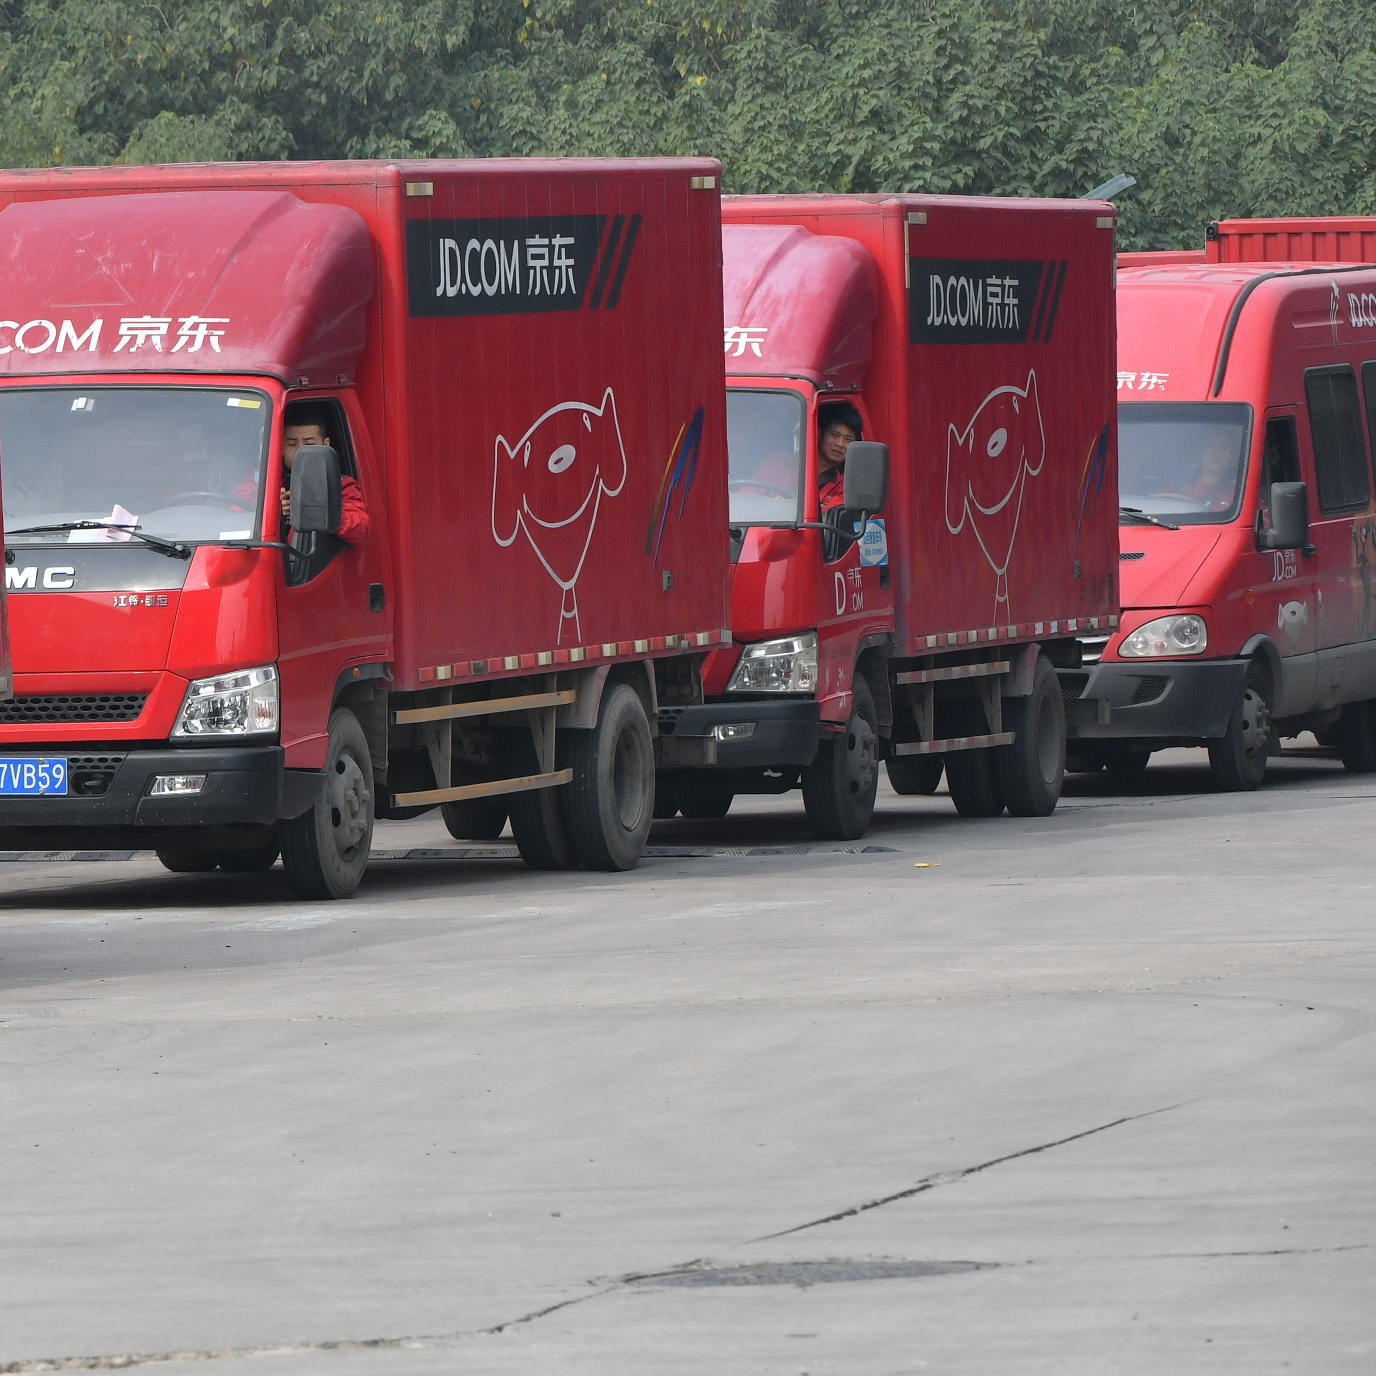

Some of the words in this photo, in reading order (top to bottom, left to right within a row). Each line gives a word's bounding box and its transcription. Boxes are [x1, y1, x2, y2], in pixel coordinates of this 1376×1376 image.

[436, 238, 521, 298] JD.COM
[525, 233, 577, 296] 京东
[927, 275, 983, 327] JD.COM
[986, 275, 1020, 330] 京东
[112, 315, 231, 353] 京东
